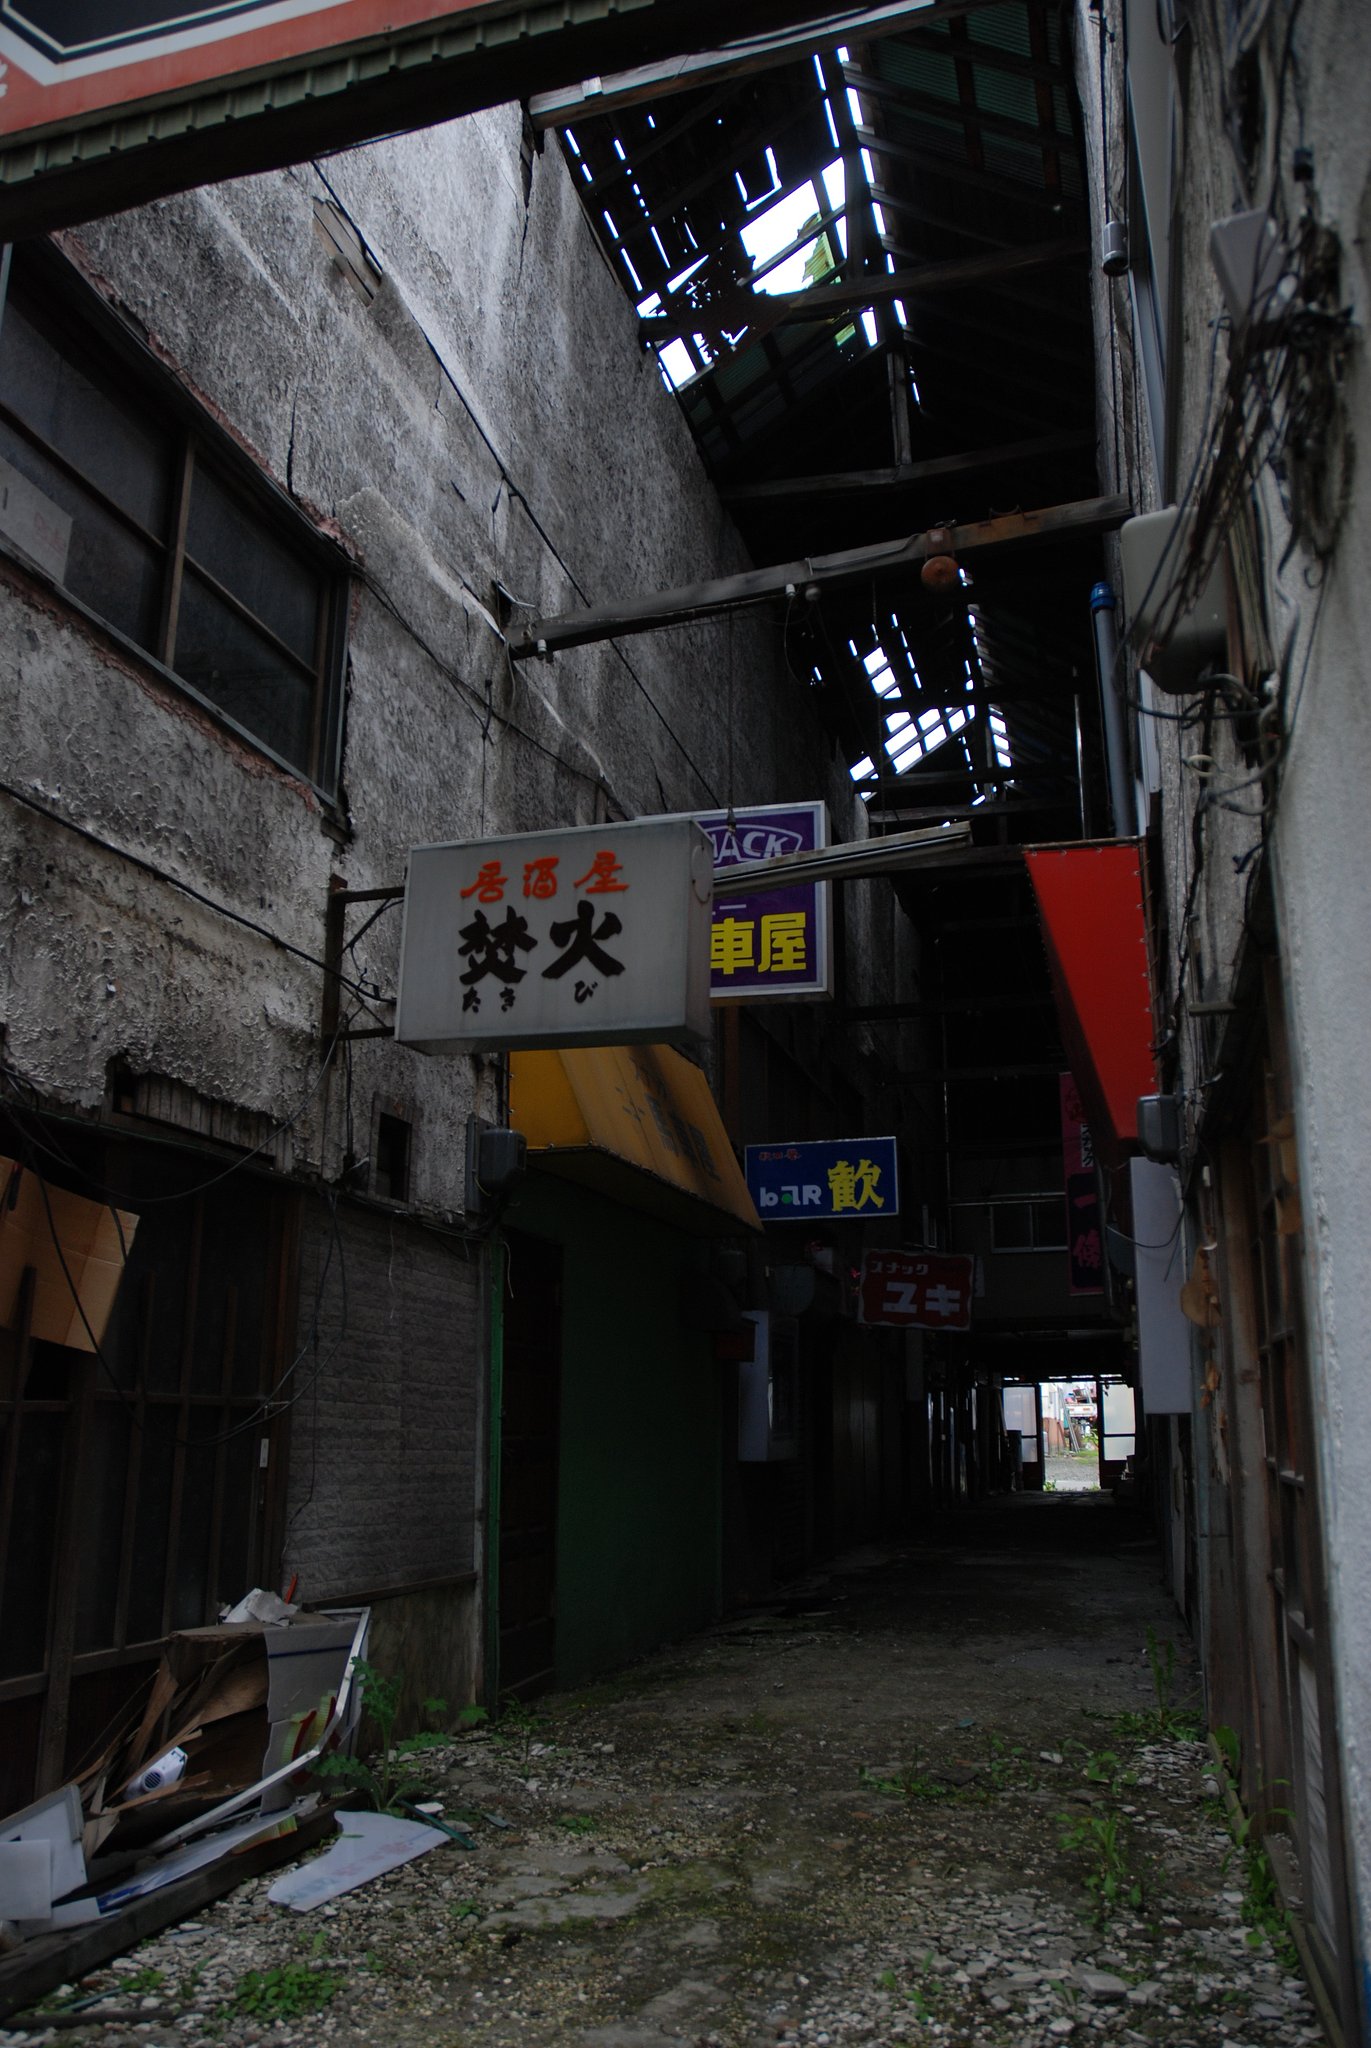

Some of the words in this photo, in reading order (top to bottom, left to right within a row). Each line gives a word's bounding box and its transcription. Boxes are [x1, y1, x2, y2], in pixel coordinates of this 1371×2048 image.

[712, 830, 789, 862] ACK
[460, 851, 629, 903] 居酒屋
[458, 900, 626, 985] 焚火
[462, 980, 598, 1013] たきび
[827, 1158, 885, 1213] 歓
[870, 1260, 929, 1276] スナック
[882, 1280, 961, 1317] ユキ
